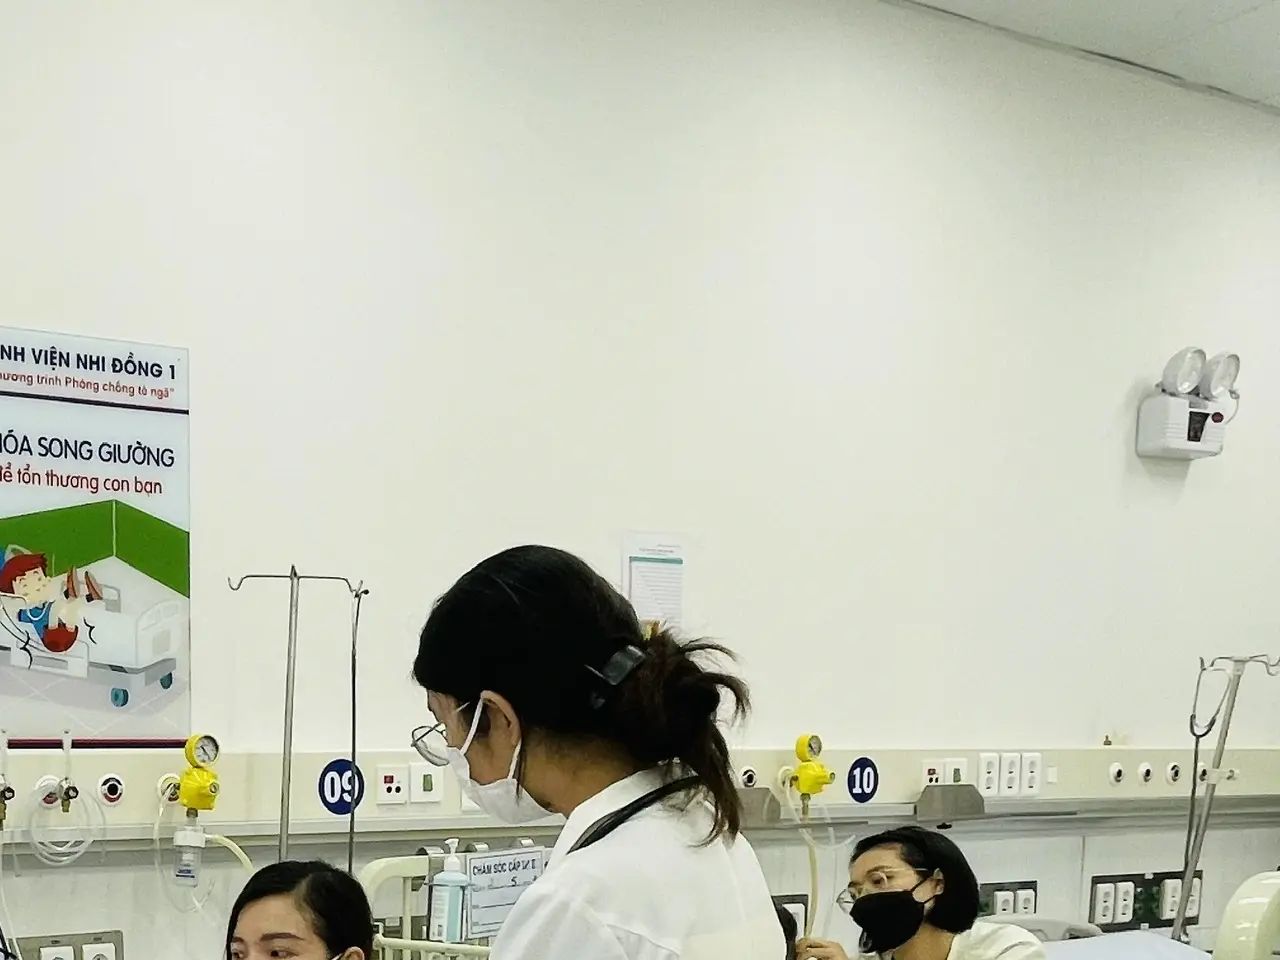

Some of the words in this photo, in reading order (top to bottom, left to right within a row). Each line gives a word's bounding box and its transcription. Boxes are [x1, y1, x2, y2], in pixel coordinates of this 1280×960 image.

[31, 346, 70, 371] VIỆN
[76, 353, 106, 372] NHI
[111, 352, 163, 378] ĐỒNG
[168, 364, 175, 380] 1
[37, 436, 93, 460] SONG
[98, 441, 175, 467] GIƯỜNG
[18, 464, 41, 486] tổn
[45, 469, 99, 494] thương
[103, 477, 130, 492] con
[134, 476, 163, 496] bạn
[323, 770, 359, 804] 09
[852, 766, 874, 793] 10
[472, 863, 493, 876] CHĂM
[493, 861, 507, 874] SÓC
[509, 858, 521, 872] CẤP
